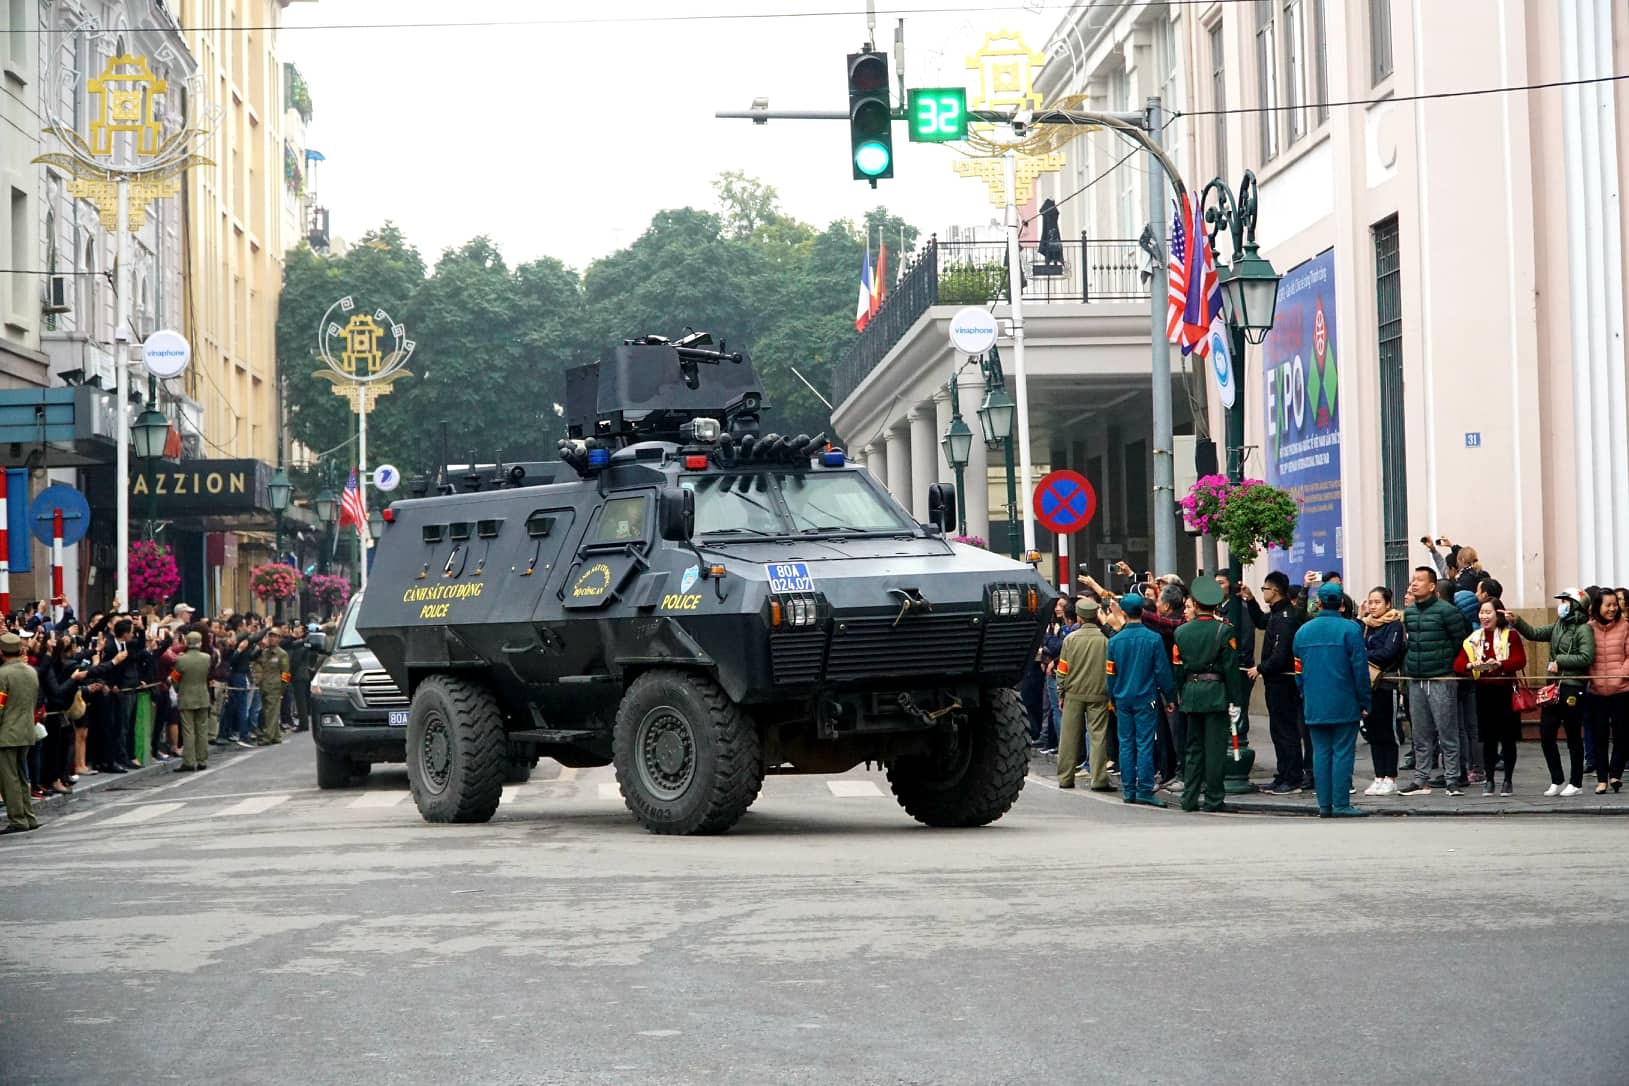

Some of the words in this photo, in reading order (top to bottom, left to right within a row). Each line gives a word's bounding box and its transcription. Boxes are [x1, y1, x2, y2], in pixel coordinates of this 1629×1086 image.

[918, 98, 959, 133] 32
[954, 326, 993, 335] vinaphone
[1267, 354, 1305, 456] EXPO
[1467, 433, 1477, 446] 31
[128, 472, 245, 495] AZZION
[776, 564, 800, 578] 80A
[772, 577, 809, 591] 024.07
[661, 595, 702, 610] POLICE
[420, 603, 450, 619] POLICE
[391, 713, 408, 724] 80A
